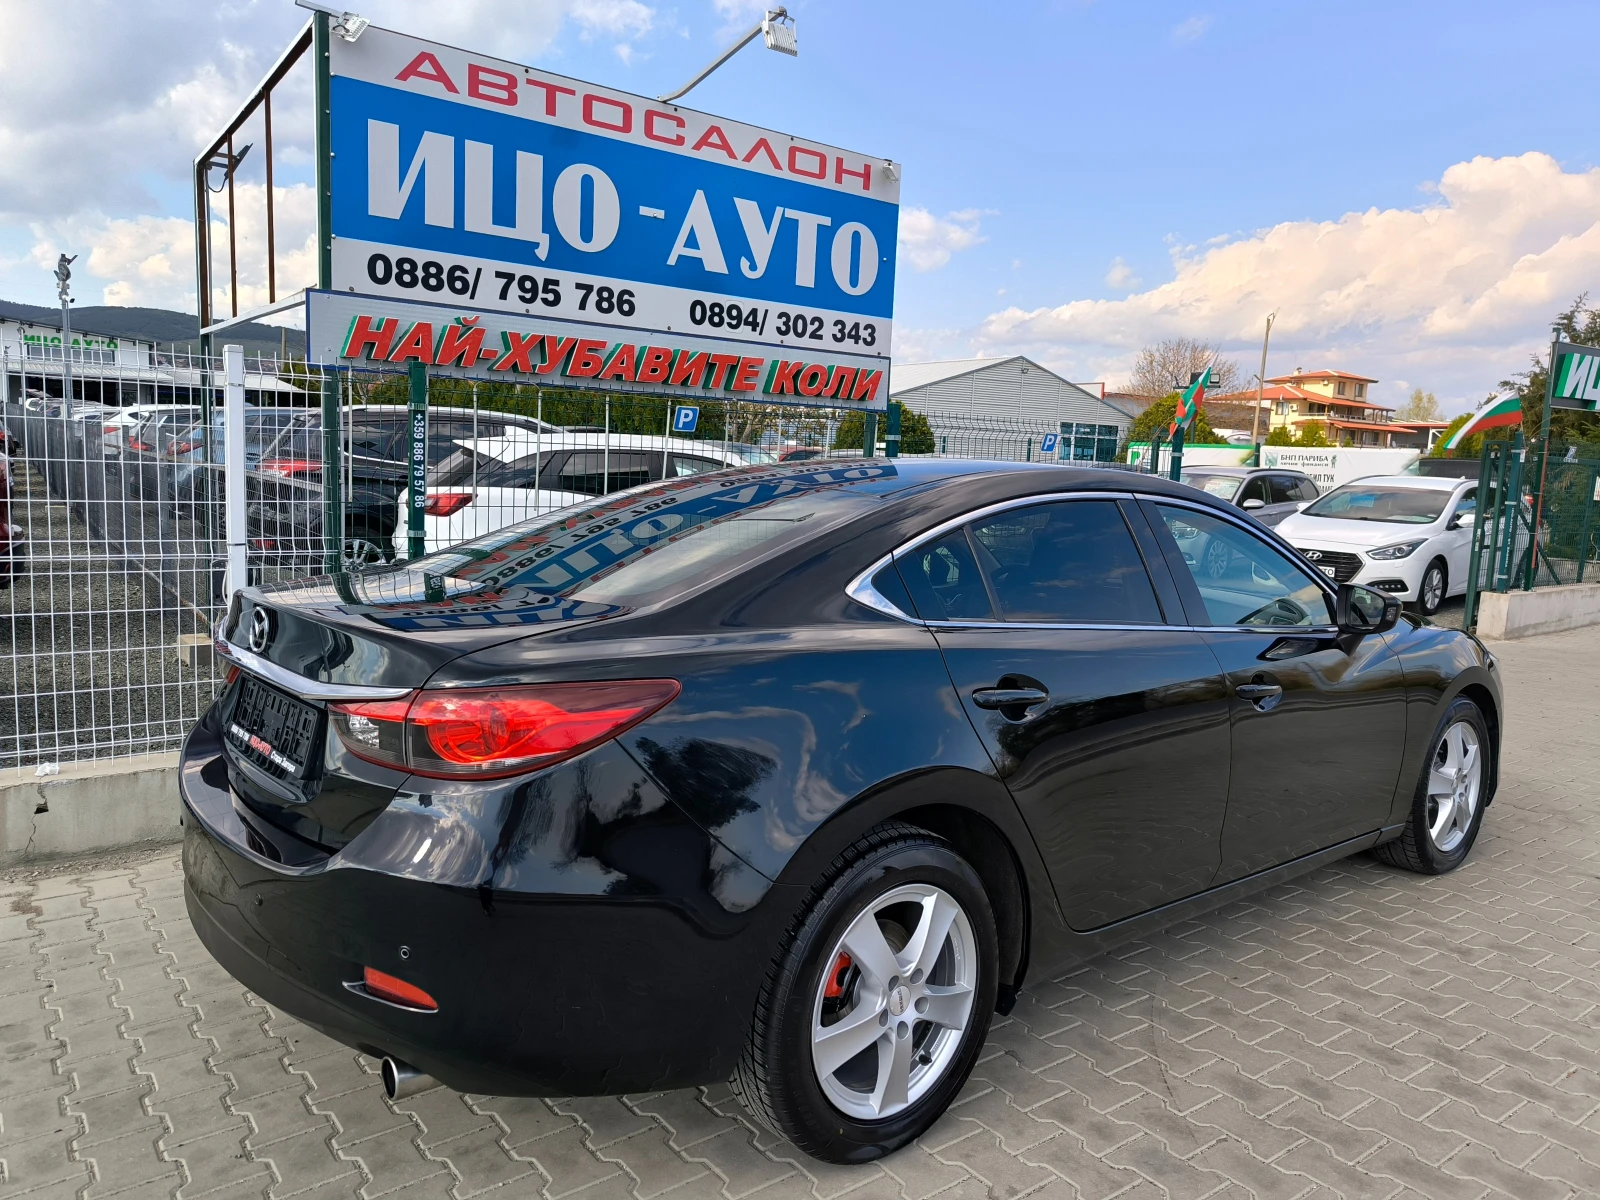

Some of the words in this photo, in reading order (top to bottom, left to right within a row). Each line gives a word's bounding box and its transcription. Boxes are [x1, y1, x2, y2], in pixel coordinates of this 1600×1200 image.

[394, 51, 872, 191] АВТОСАЛОН
[367, 253, 482, 300] 0886/
[494, 270, 562, 308] 795
[574, 282, 636, 317] 786
[689, 299, 769, 336] 0894/
[775, 311, 824, 341] 302
[831, 319, 877, 346] 343
[340, 315, 764, 391] НАЙ-ХУБАВИТЕ
[762, 359, 883, 401] КОЛИ
[414, 413, 424, 439] +359
[678, 409, 693, 428] P
[413, 442, 424, 461] 886
[1043, 434, 1055, 450] P
[414, 464, 424, 476] 79
[414, 480, 424, 493] 57
[414, 496, 424, 508] 86
